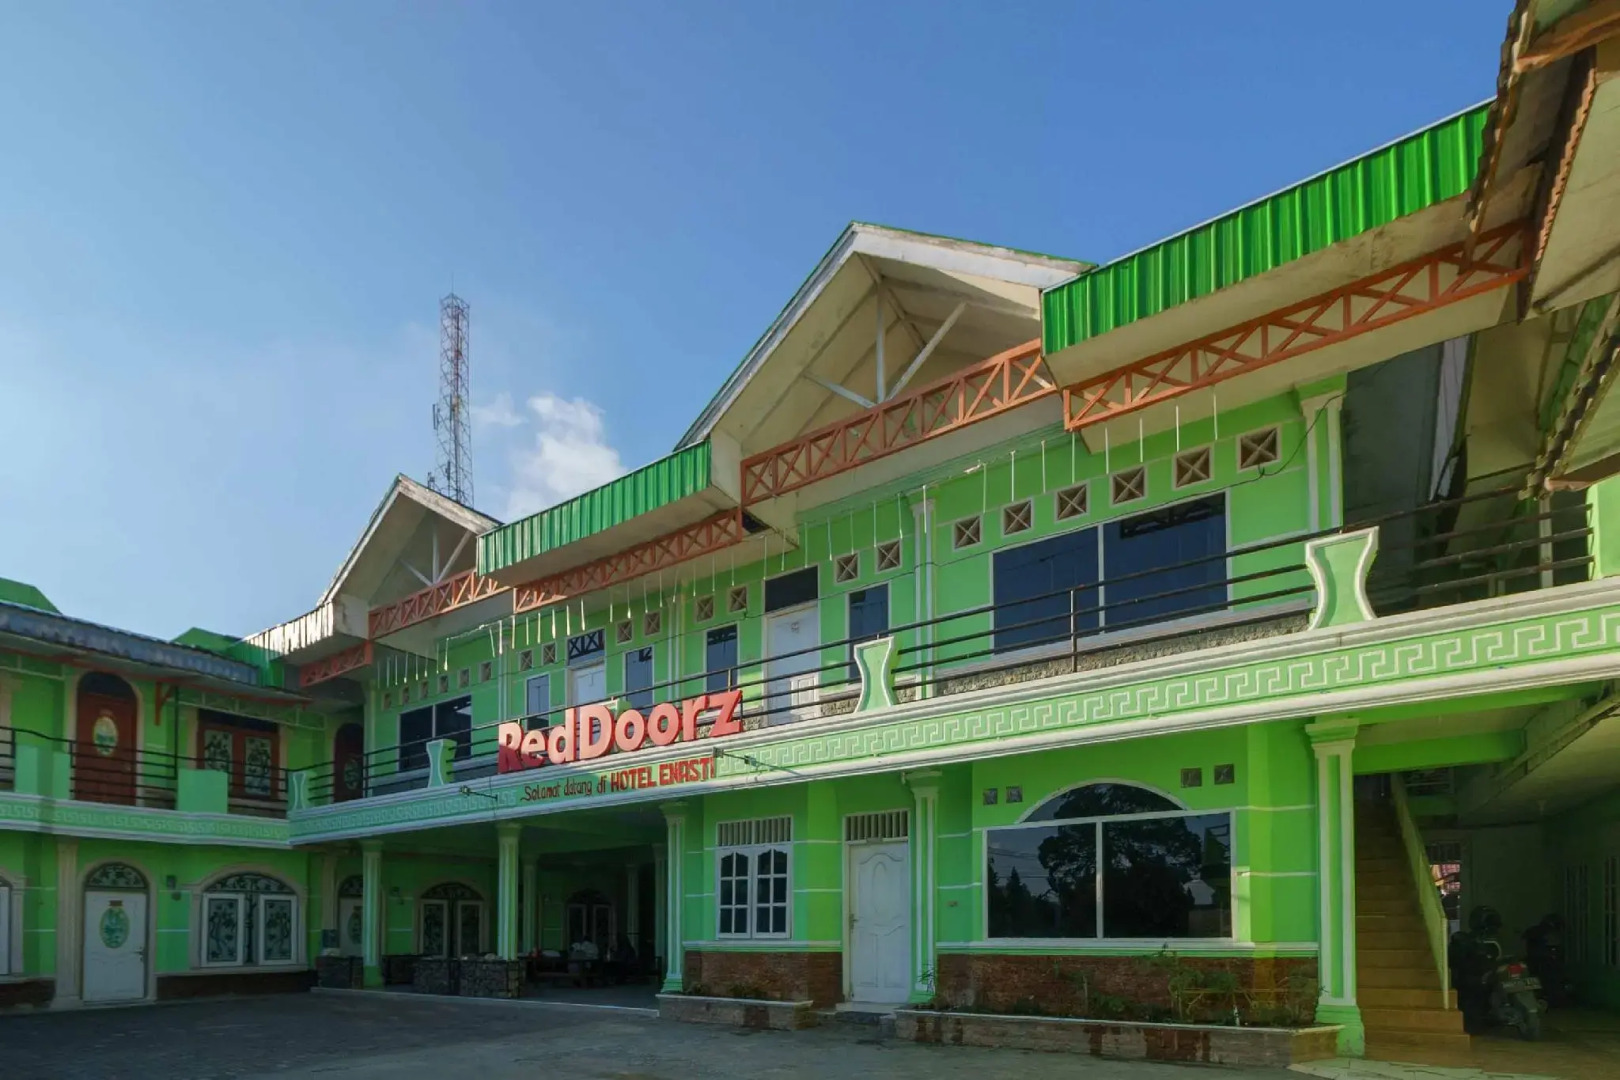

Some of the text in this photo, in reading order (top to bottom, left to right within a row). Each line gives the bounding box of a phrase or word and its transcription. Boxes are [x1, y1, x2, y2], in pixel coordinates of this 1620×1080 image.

[498, 689, 743, 773] RedDoorz
[610, 766, 657, 792] HOTEL
[659, 757, 715, 786] ENASTI
